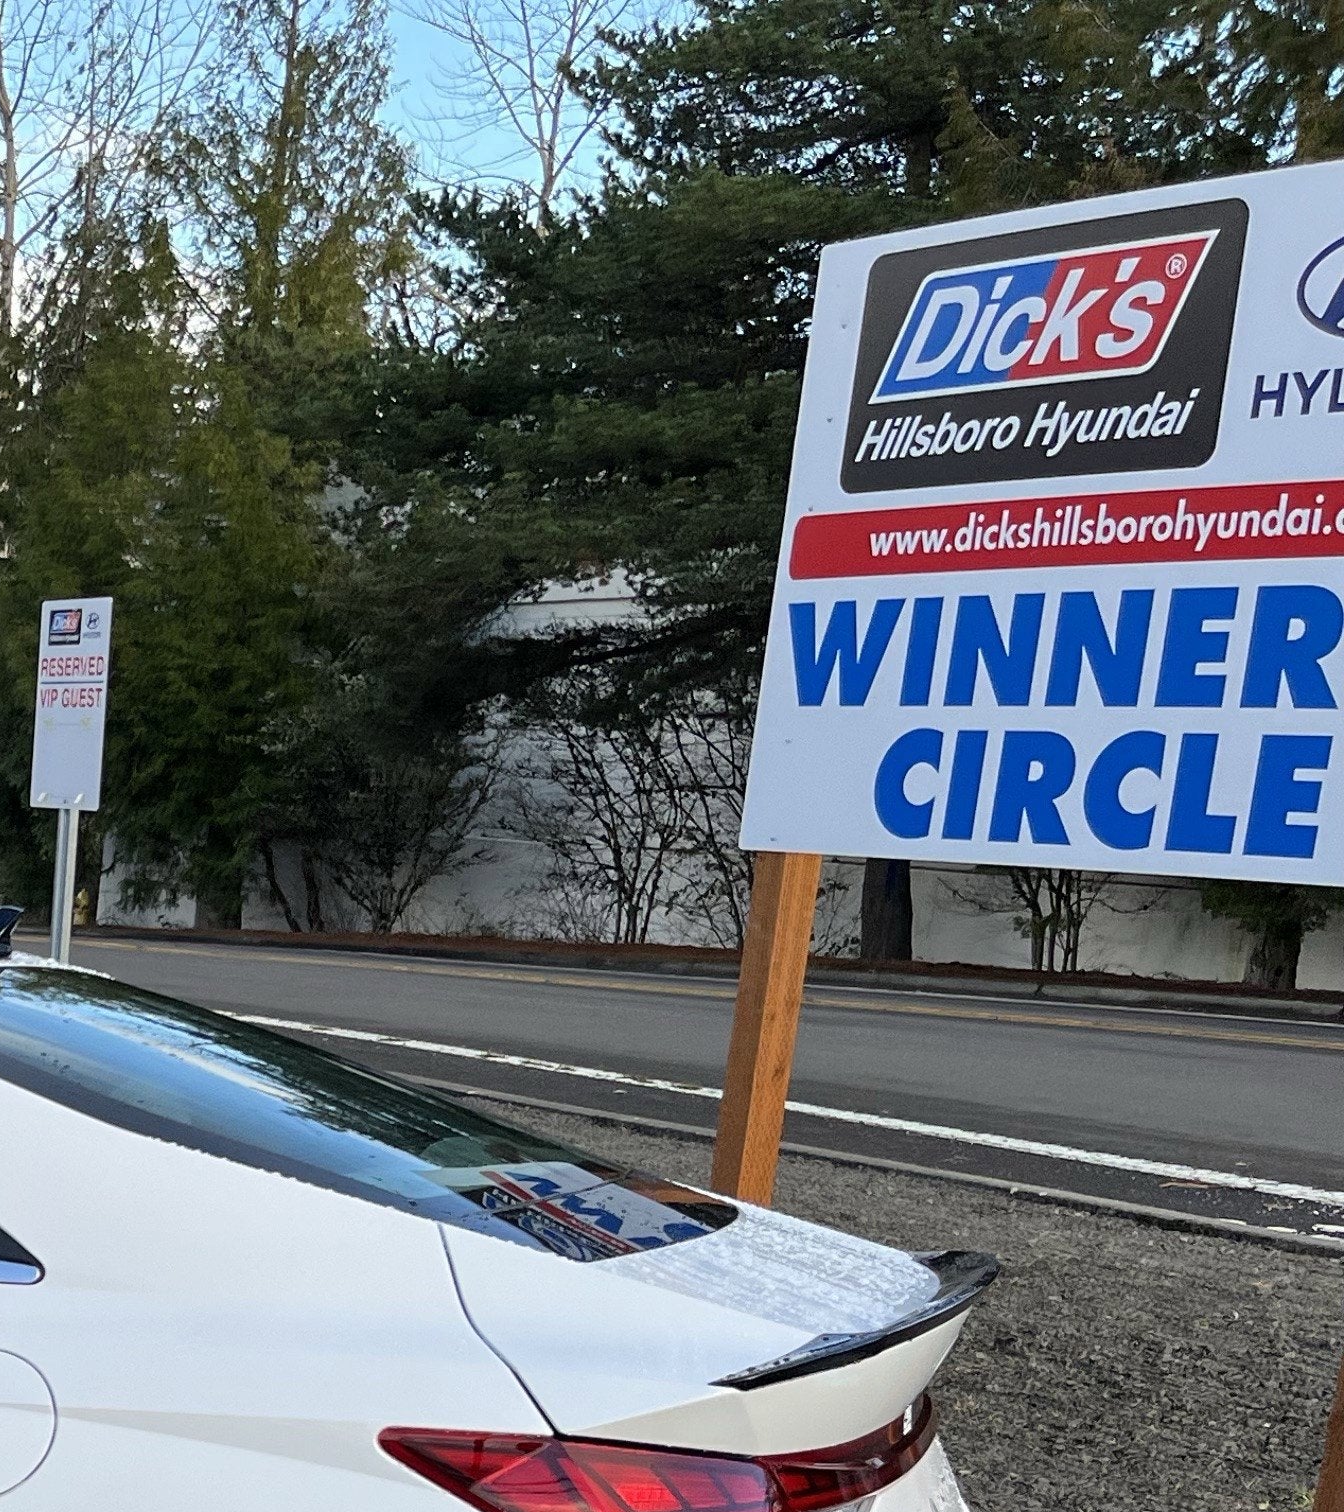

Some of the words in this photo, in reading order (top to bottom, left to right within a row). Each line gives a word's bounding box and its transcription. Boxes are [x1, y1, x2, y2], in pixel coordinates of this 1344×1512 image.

[895, 256, 1166, 382] Dick's
[855, 411, 1021, 462] Hillsboro
[1024, 388, 1201, 458] Hyundai
[40, 656, 104, 677] RESERVED
[789, 585, 1344, 708] WINNER
[40, 688, 59, 708] VIP
[61, 687, 103, 708] GUEST
[874, 728, 1334, 859] CIRCLE
